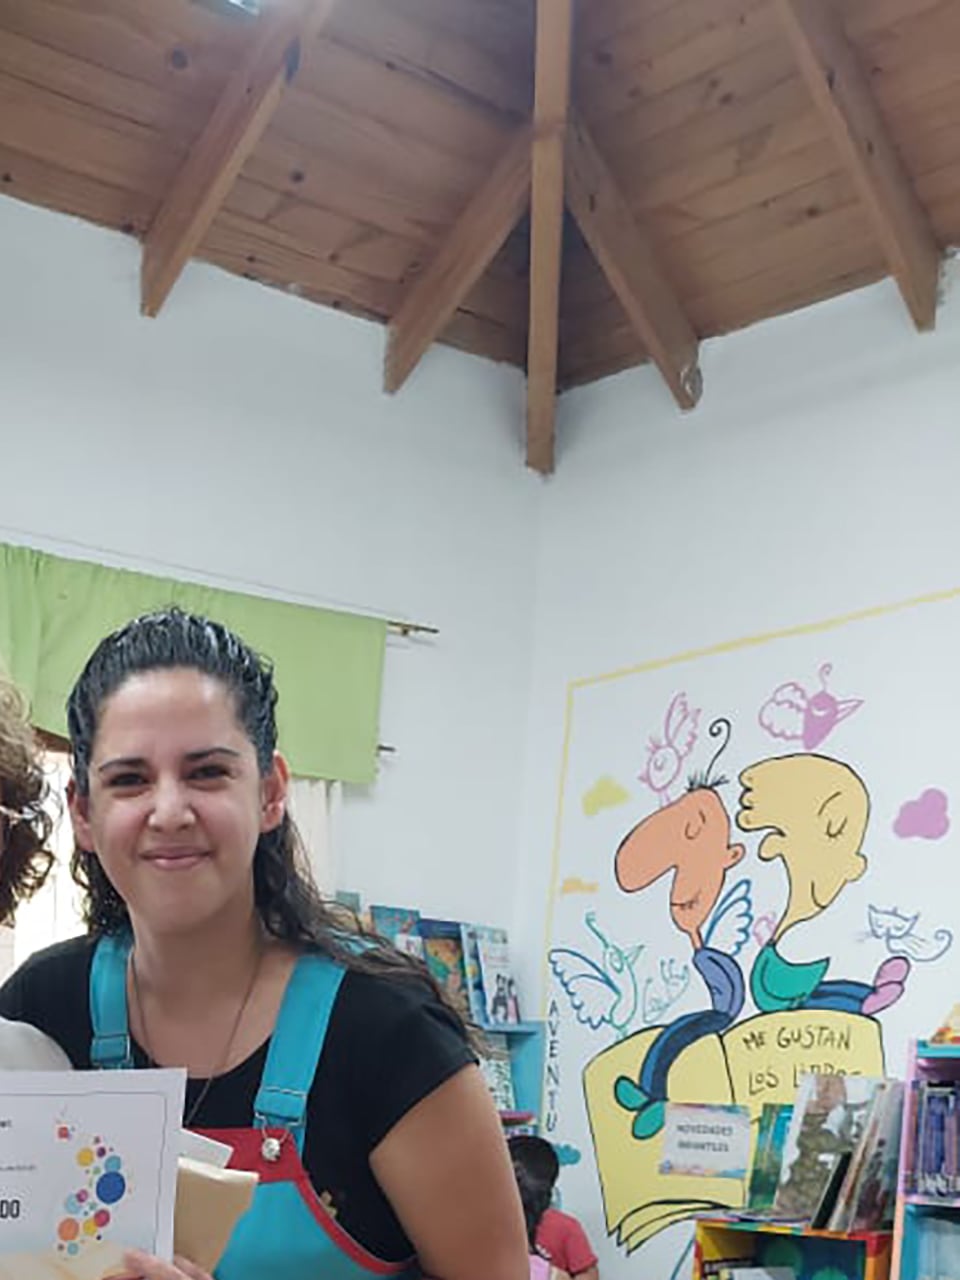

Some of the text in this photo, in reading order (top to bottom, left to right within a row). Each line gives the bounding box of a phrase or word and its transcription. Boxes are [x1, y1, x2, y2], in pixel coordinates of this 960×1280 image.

[742, 1024, 852, 1049] ME GUSTAN
[748, 1068, 779, 1096] LOS
